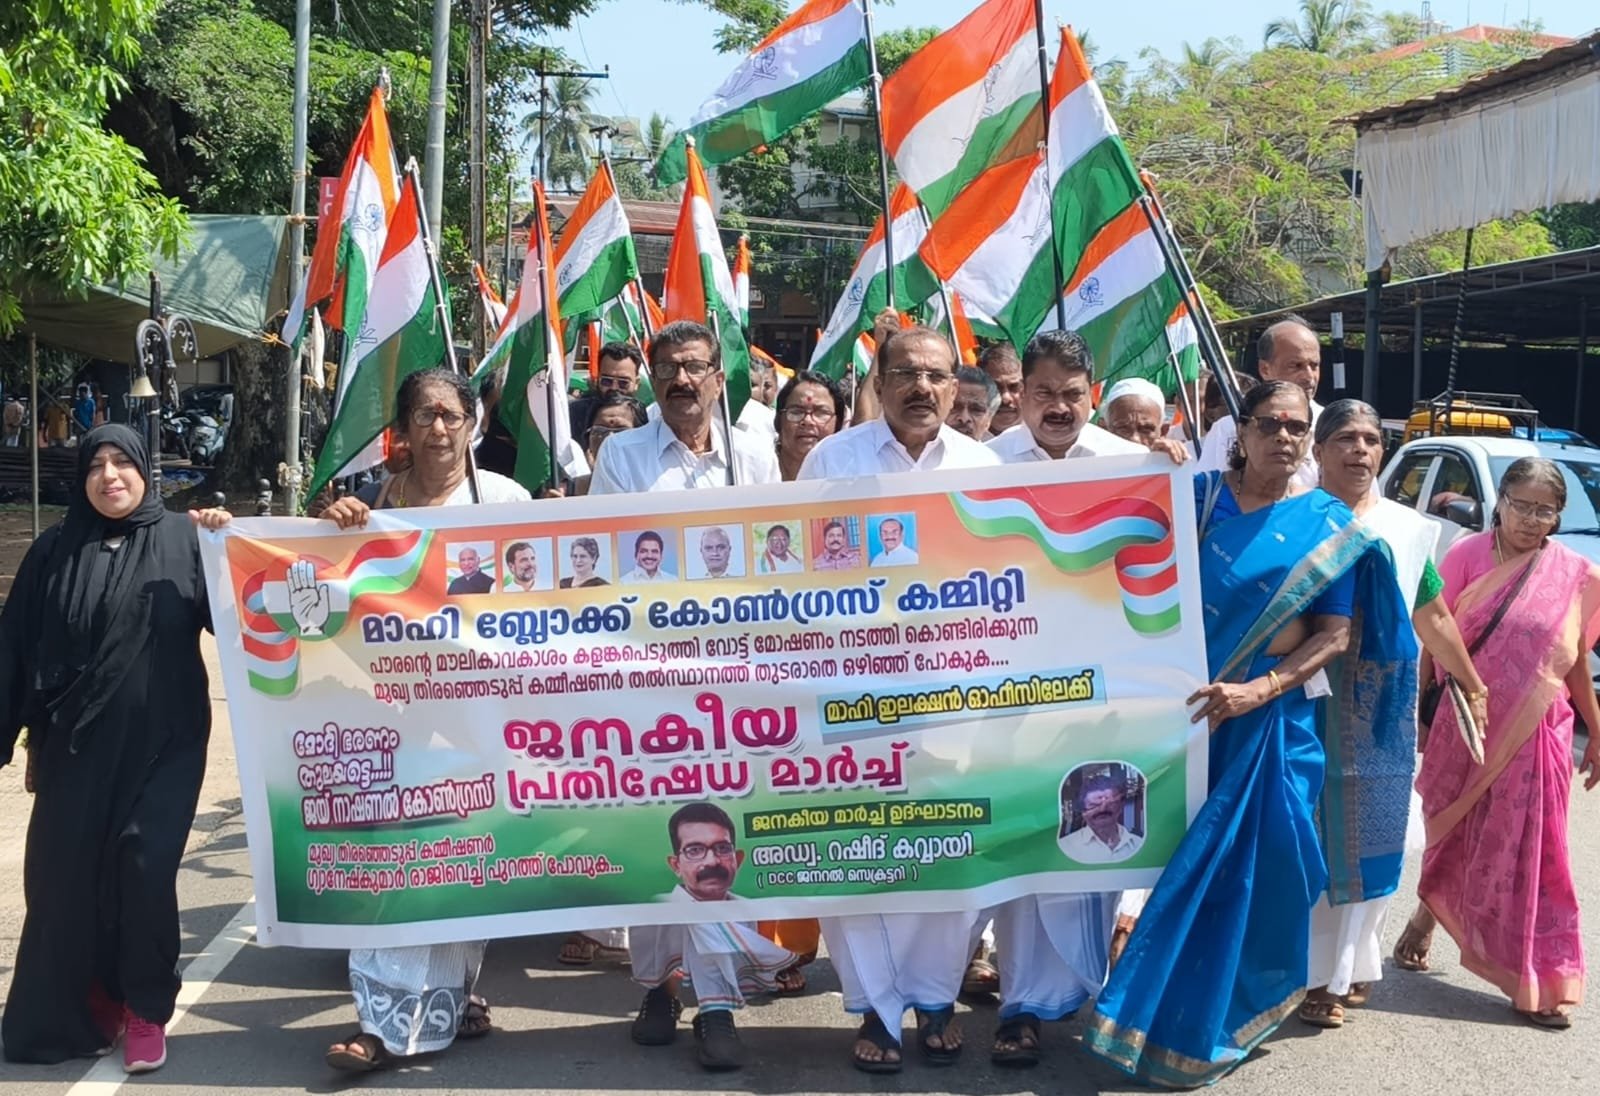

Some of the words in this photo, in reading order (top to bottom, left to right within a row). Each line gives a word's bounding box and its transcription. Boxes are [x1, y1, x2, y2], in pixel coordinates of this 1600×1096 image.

[362, 606, 461, 643] മാഹി
[476, 596, 638, 645] ബ്ലോക്ക്
[648, 578, 886, 629] കോൺഗ്രസ്
[897, 568, 1026, 612] കമ്മിറ്റി
[436, 648, 567, 672] മൗലികാവകാശം
[573, 636, 701, 668] കളങ്കപെടുത്തി
[706, 632, 750, 658] വോട്ട്
[754, 631, 834, 654] മോഷണം
[839, 623, 899, 648] നടത്തി
[905, 616, 1039, 643] കൊണ്ടിരിക്കുന്ന
[374, 682, 411, 705] മുഖ്യ
[413, 674, 524, 699] തിരഞ്ഞെടുപ്പ്
[528, 669, 623, 695] കമ്മീഷണർ
[629, 661, 750, 689] തൽസ്ഥാനത്ത്
[755, 661, 837, 685] തുടരാതെ
[842, 650, 911, 677] ഒഴിഞ്ഞ്
[824, 693, 875, 724] മാഹി
[876, 686, 964, 725] ഇലക്ഷൻ
[965, 671, 1096, 710] ഓഫീസിലേക്ക്
[294, 722, 340, 759] മോദി
[341, 726, 400, 753] ഭരണം
[503, 692, 798, 760] ജനകീയ
[302, 789, 332, 826] ജയ്
[332, 786, 400, 824] നാഷണൽ
[402, 773, 496, 819] കോൺഗ്രസ്
[506, 755, 750, 809] പ്രതിഷേധ
[771, 740, 911, 787] മാർച്ച്
[751, 808, 828, 832] ജനകീയ
[834, 802, 885, 825] മാർച്ച്
[890, 801, 983, 825] ഉദ്ഘാടനം
[308, 843, 336, 866] മുഖ്യ
[337, 841, 417, 865] തിരഞ്ഞെടുപ്പ്
[409, 856, 486, 887] രാജിവെച്ച്
[489, 853, 544, 885] പുറത്ത്
[751, 842, 822, 867] അഡ്വ.
[827, 833, 889, 862] റഷീദ്
[892, 832, 973, 864] കവ്വായി
[768, 872, 795, 885] DCC
[796, 867, 845, 884] ജനറൽ
[848, 865, 906, 883] സെക്രട്ടറി
